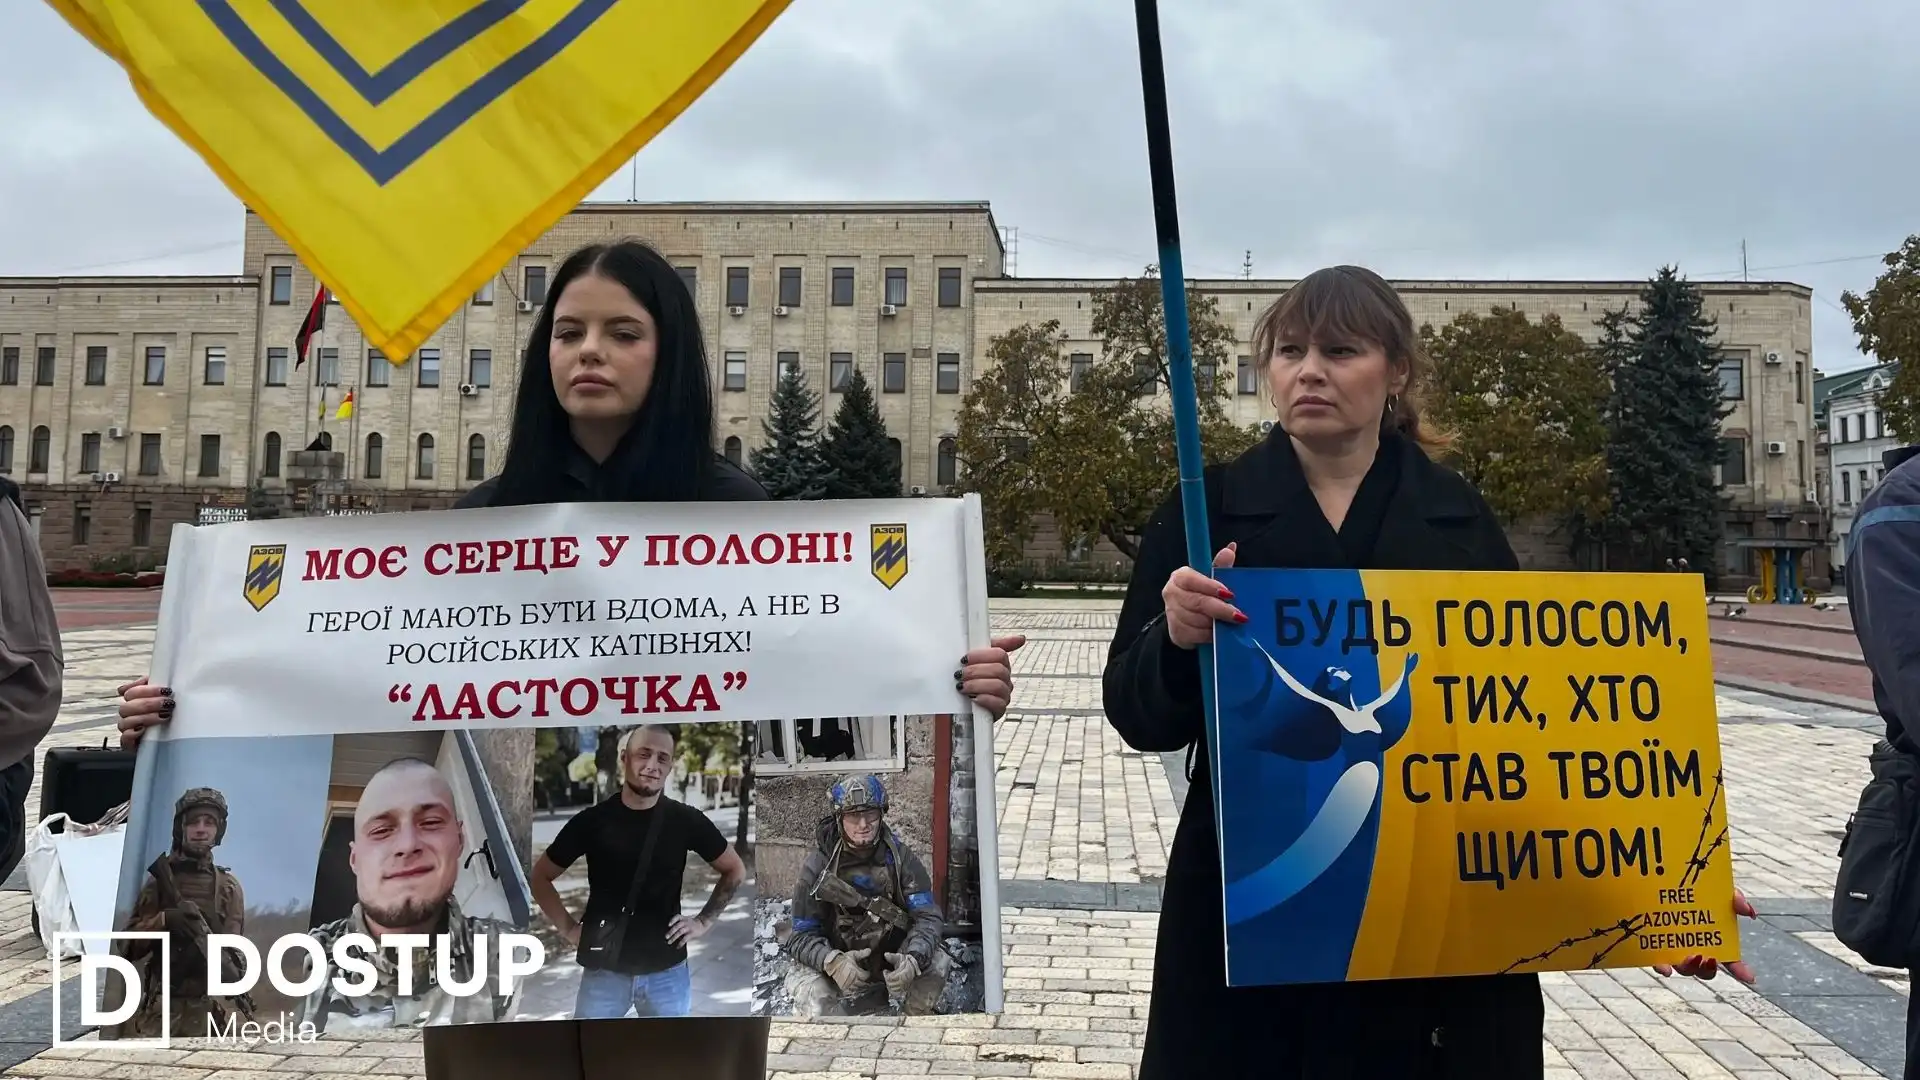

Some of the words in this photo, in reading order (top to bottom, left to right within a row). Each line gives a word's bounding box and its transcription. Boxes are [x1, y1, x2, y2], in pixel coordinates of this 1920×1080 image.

[302, 545, 408, 582] МОЄ
[424, 536, 580, 576] СЕРЦЕ
[596, 535, 630, 568] У
[644, 531, 854, 567] ПОЛОНІ!
[306, 605, 394, 633] ГЕРОЇ
[400, 605, 512, 631] МАЮТЬ
[520, 600, 597, 626] БУТИ
[606, 595, 729, 625] ВДОМА,
[737, 596, 758, 618] А
[768, 594, 811, 617] НЕ
[819, 593, 841, 615] В
[1275, 599, 1412, 655] БУДЬ
[1435, 599, 1689, 655] ГОЛОСОМ,
[386, 635, 581, 665] РОСІЙСЬКИХ
[589, 630, 753, 658] КАТІВНЯХ!
[1433, 674, 1547, 731] ТИХ,
[1566, 674, 1661, 723] ХТО
[1402, 752, 1528, 803] СТАВ
[1547, 738, 1702, 800] ТВОЇМ
[1456, 826, 1665, 891] ЩИТОМ!
[1642, 909, 1716, 928] AZOVSTAL
[1659, 887, 1696, 905] FREE
[1639, 930, 1723, 950] DEFENDERS
